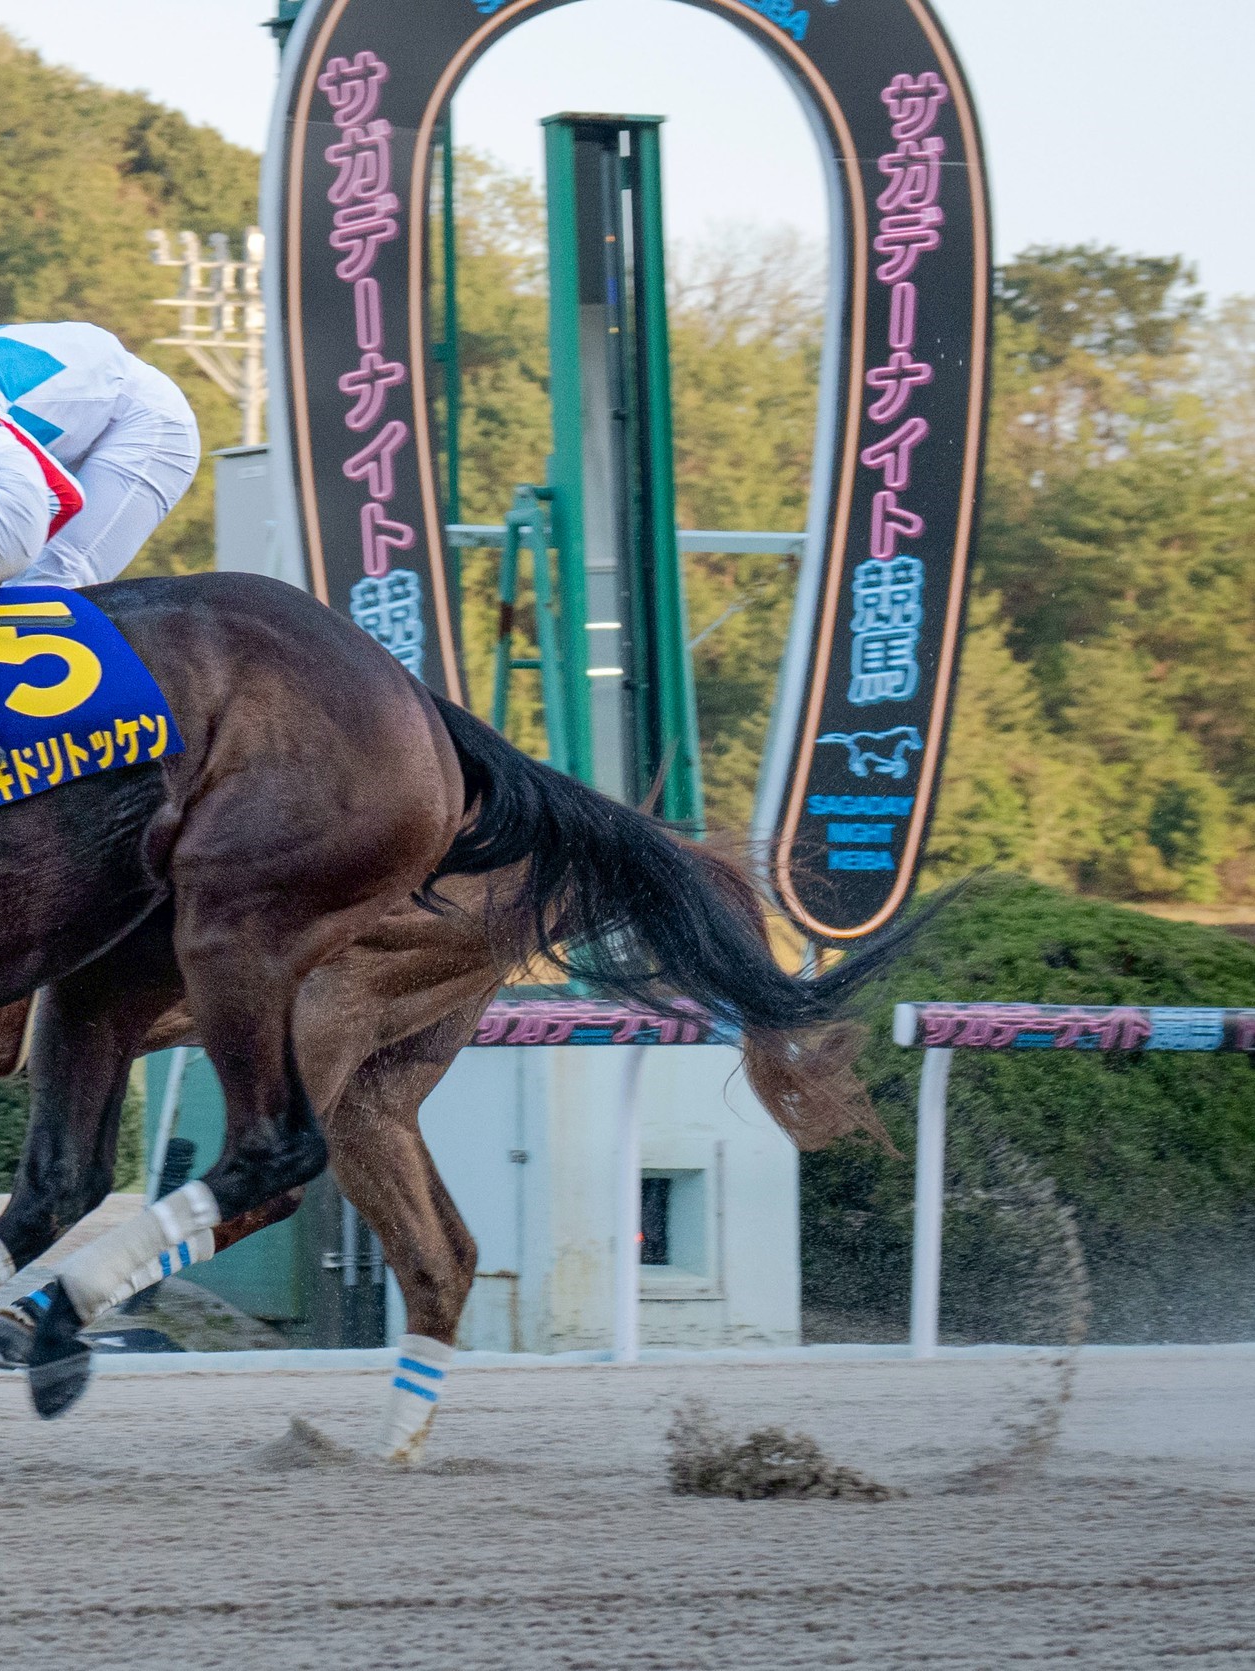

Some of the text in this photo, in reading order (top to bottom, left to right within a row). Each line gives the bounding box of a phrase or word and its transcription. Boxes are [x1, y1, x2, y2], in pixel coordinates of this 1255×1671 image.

[318, 51, 425, 683] サガデーナイト競
